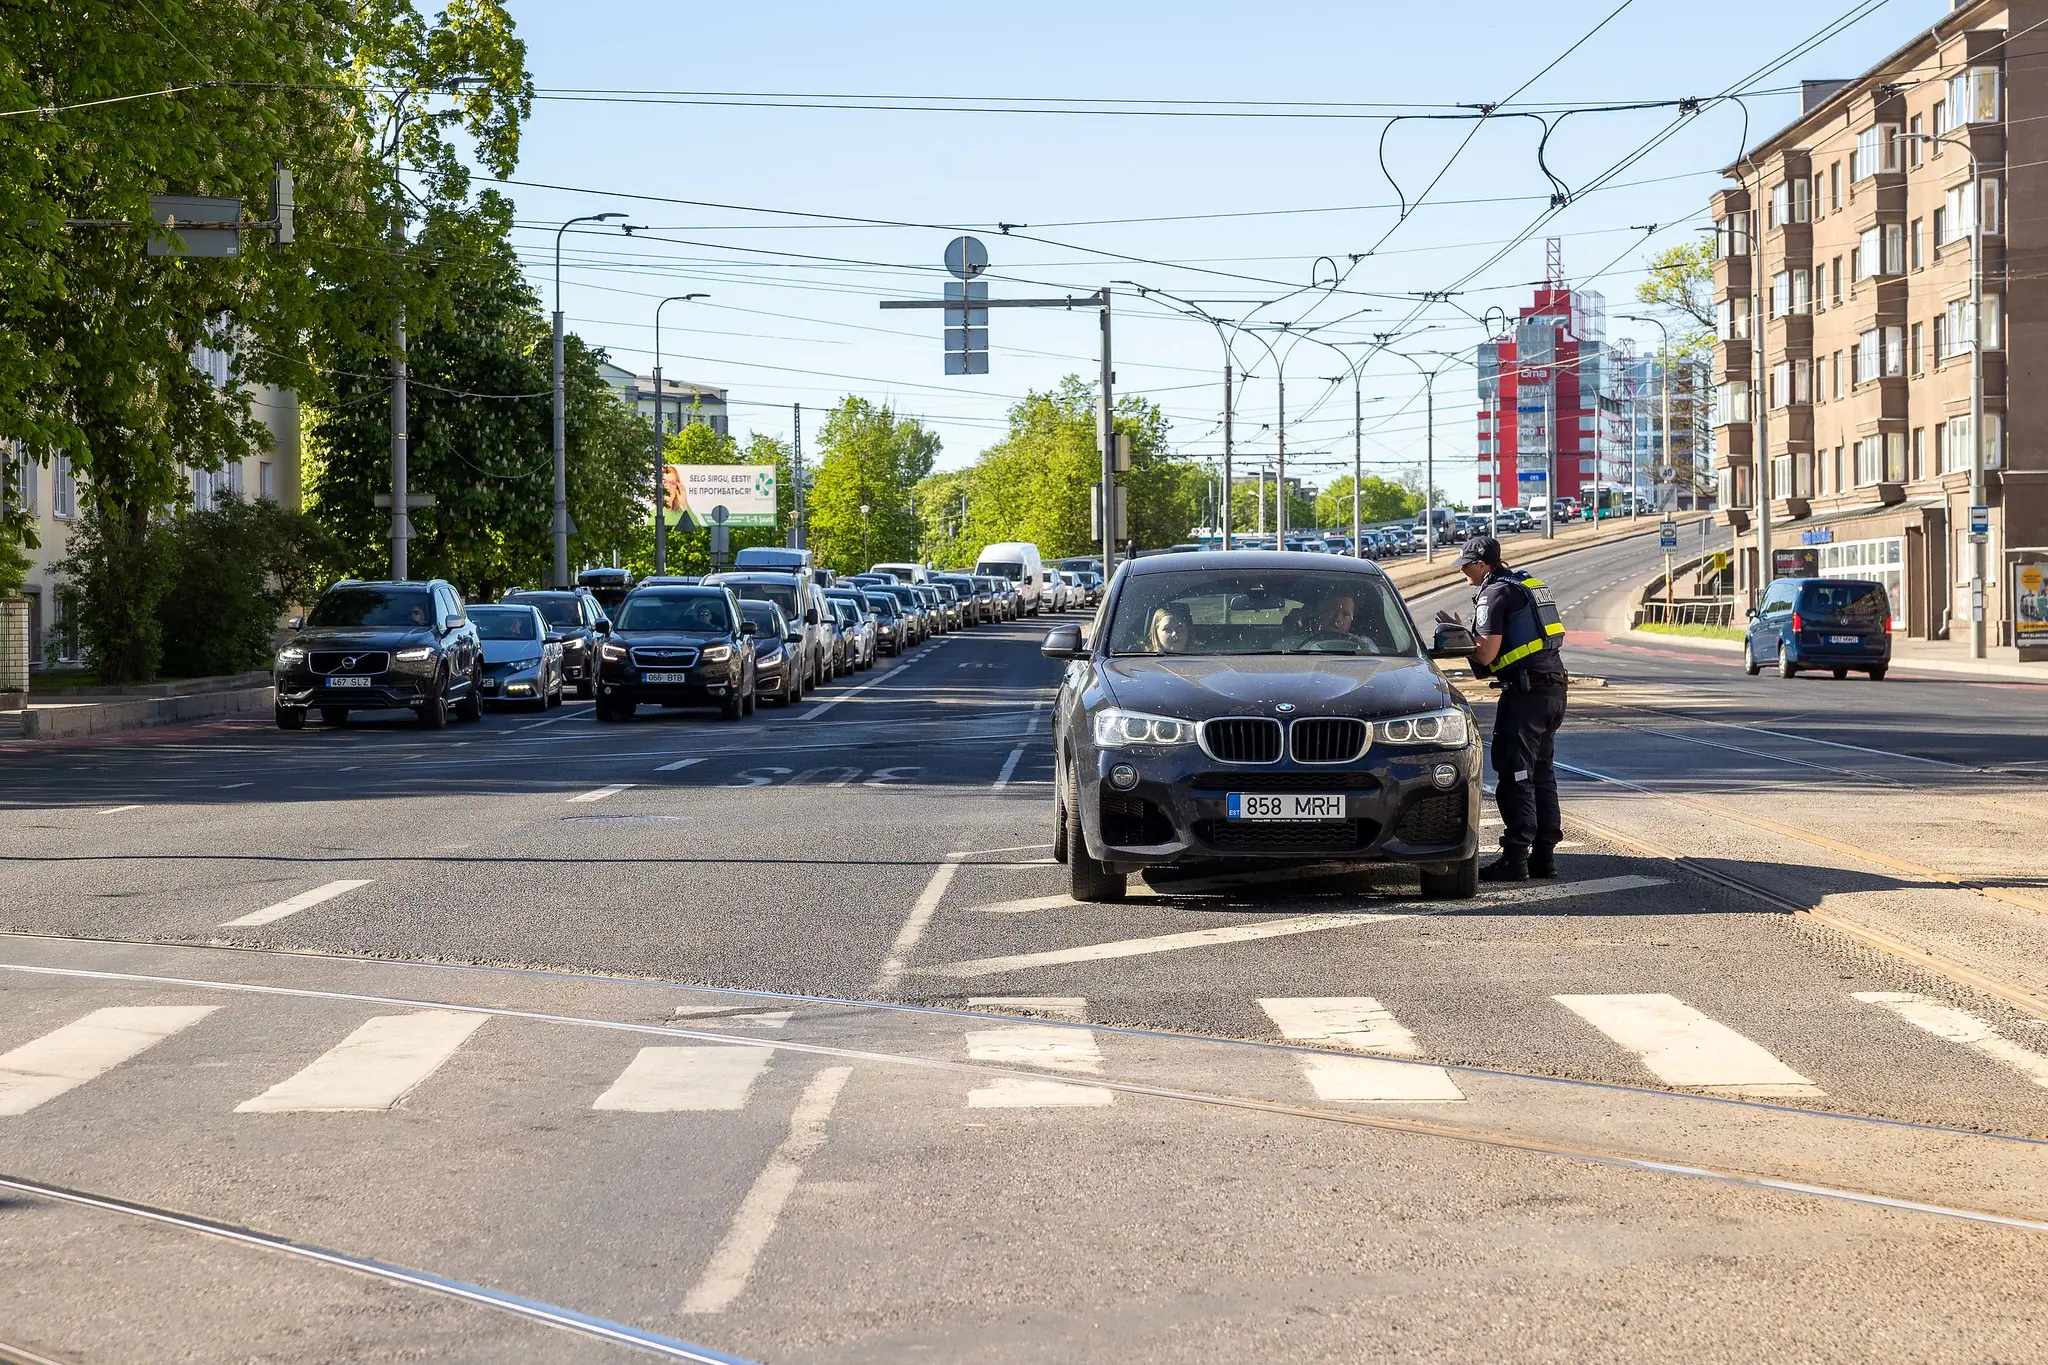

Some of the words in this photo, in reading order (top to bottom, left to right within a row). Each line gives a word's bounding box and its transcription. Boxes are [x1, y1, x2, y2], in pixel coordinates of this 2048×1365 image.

[1662, 468, 1672, 477] 40
[689, 474, 706, 483] SELG
[707, 474, 729, 484] SIRGU,
[731, 474, 751, 483] EESTI!
[688, 487, 698, 495] НЕ
[699, 487, 751, 496] ПРОГИБАТЬСЯ!
[332, 678, 347, 686] 467
[350, 678, 369, 686] SLZ
[1246, 797, 1282, 816] 858
[1295, 797, 1340, 816] MRH
